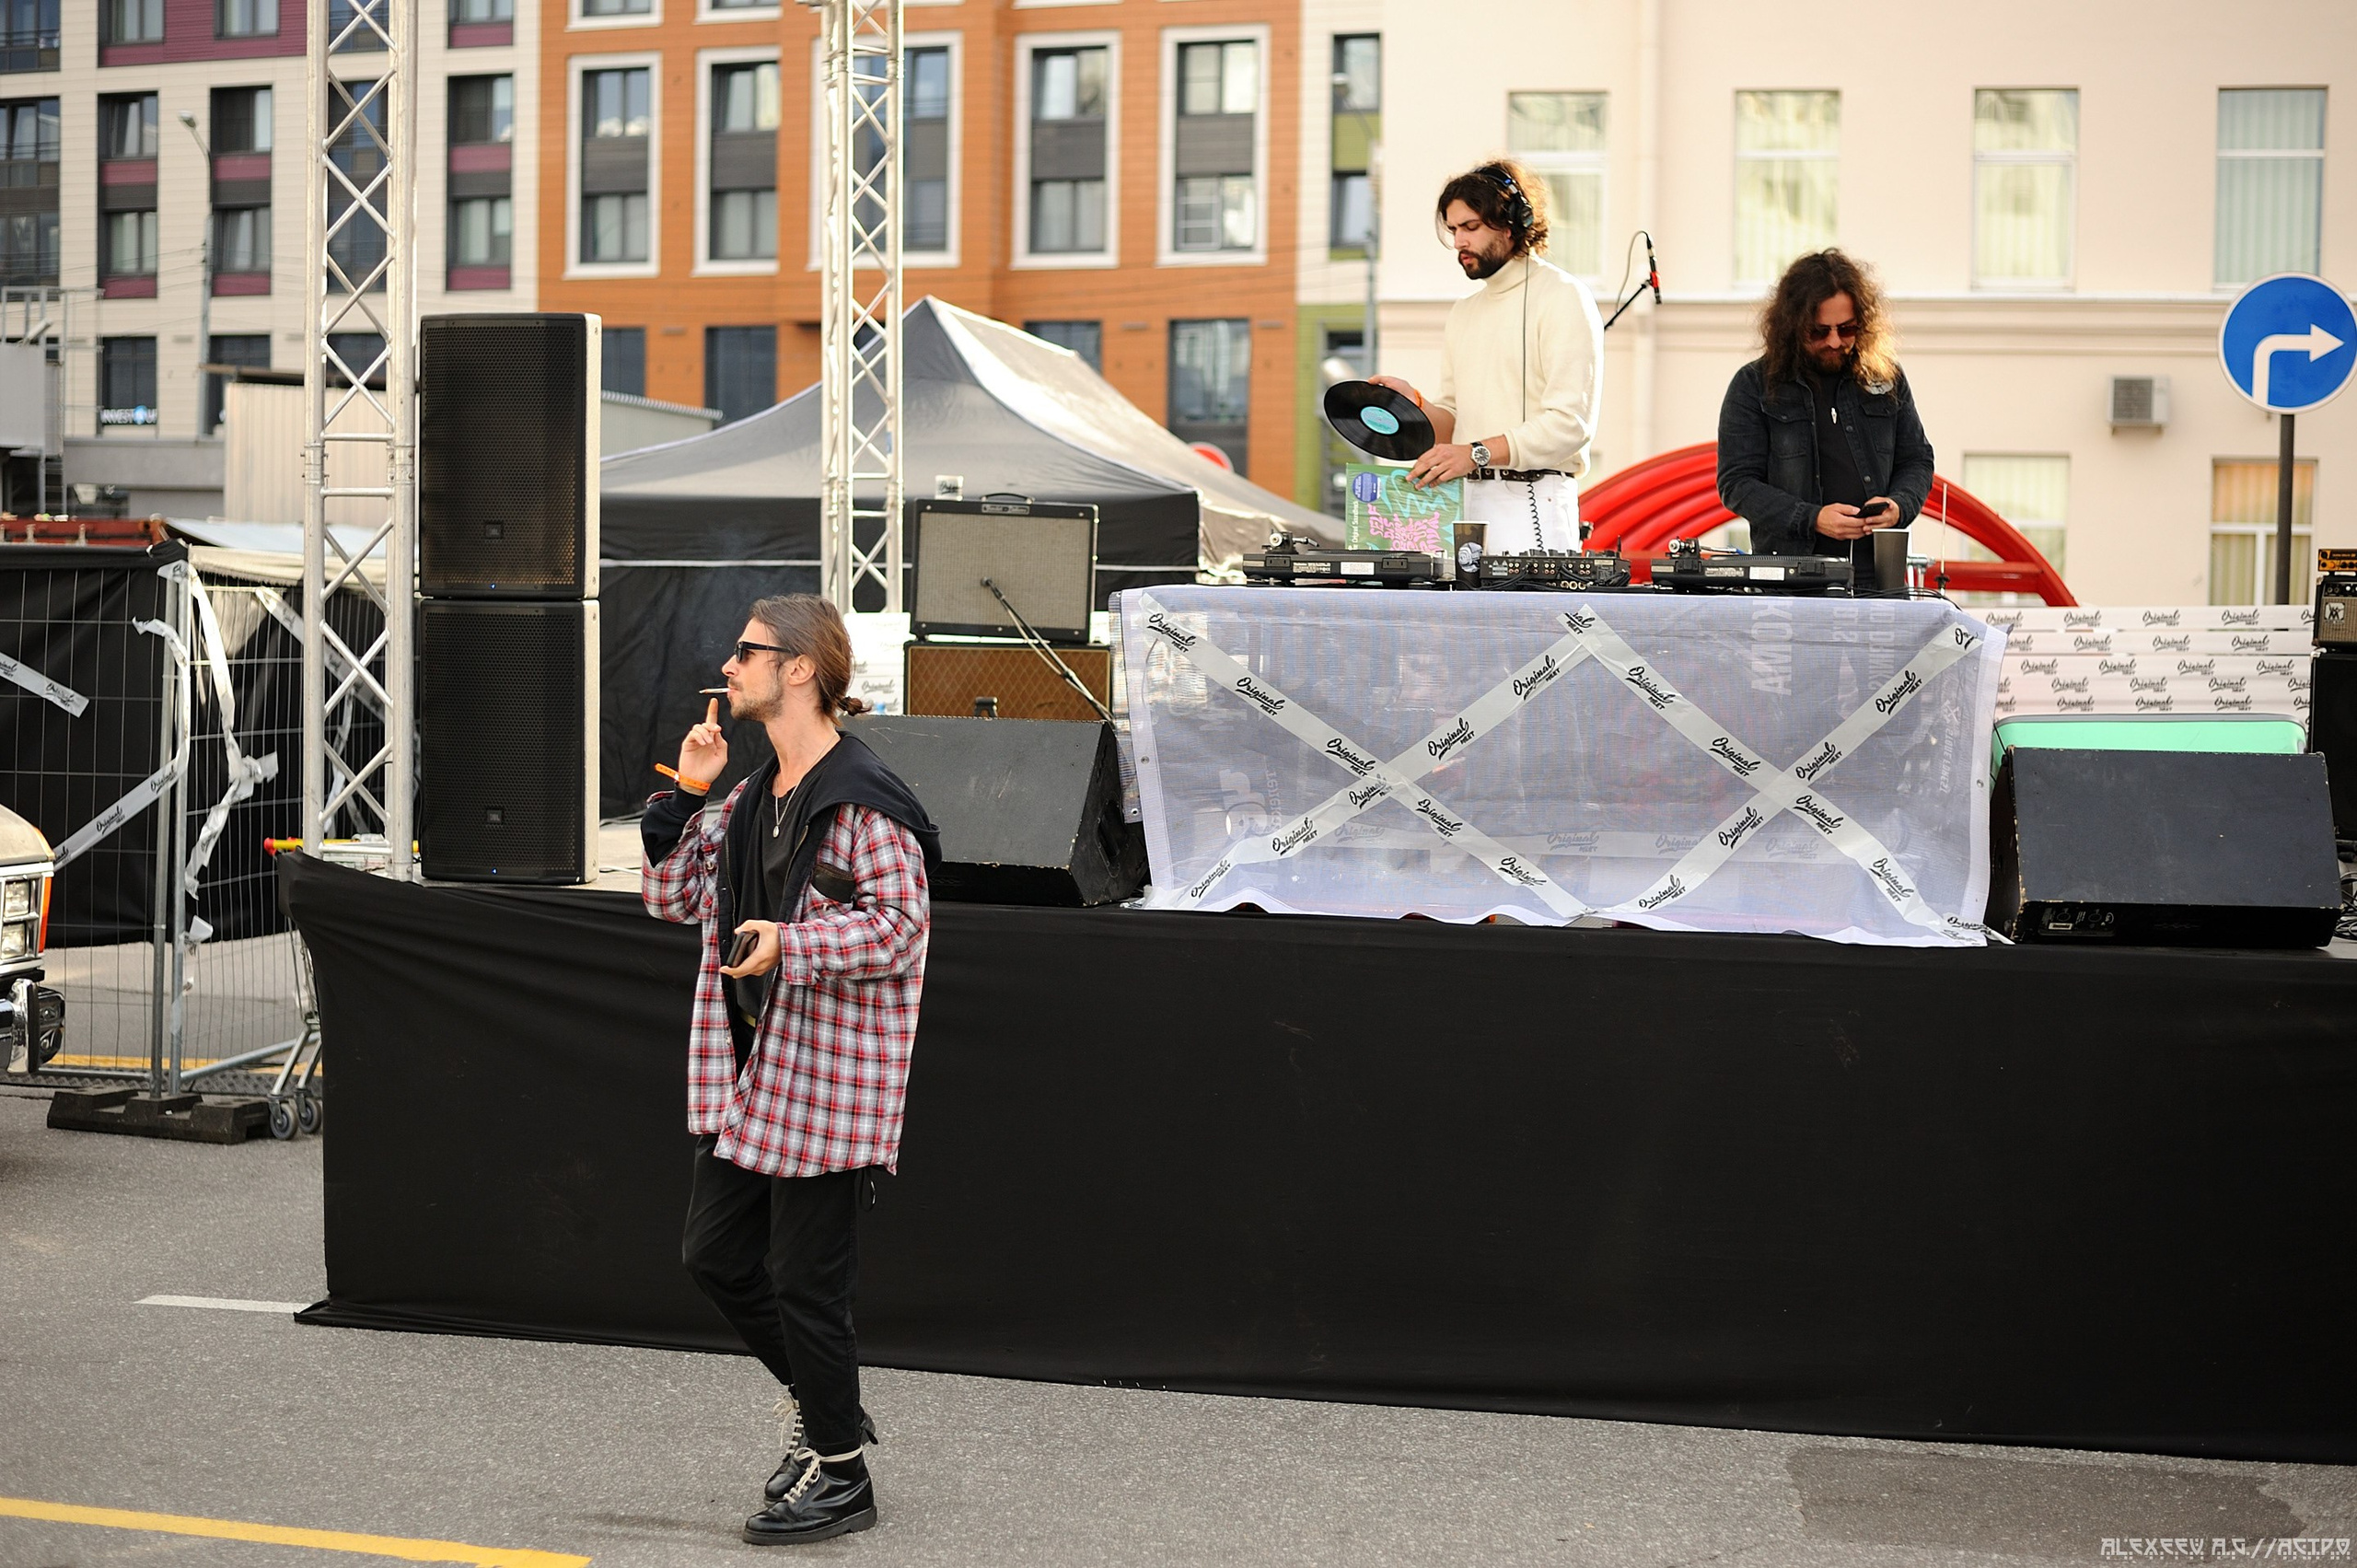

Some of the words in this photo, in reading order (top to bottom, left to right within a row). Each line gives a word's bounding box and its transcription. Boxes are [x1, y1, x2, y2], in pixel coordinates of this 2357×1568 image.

[1985, 611, 2023, 624] Original
[2063, 610, 2102, 627] Original
[2142, 610, 2180, 627] Original
[2222, 609, 2260, 626] Original
[1147, 613, 1196, 645] Original
[2073, 634, 2112, 652] Original
[2152, 634, 2190, 652] Original
[2231, 634, 2270, 652] Original
[1545, 668, 1561, 682] MEET
[2020, 658, 2058, 675] Original
[2098, 658, 2137, 675] Original
[2177, 658, 2215, 675] Original
[2256, 659, 2294, 676] Original
[1513, 655, 1556, 701] Original
[1625, 667, 1676, 703] Original
[1908, 678, 1922, 694] MEET
[2051, 677, 2089, 692] Original
[2130, 677, 2167, 692] Original
[2209, 677, 2247, 692] Original
[1235, 678, 1285, 710] Original
[1875, 669, 1916, 714] Original
[1260, 704, 1278, 716] MEET
[1648, 697, 1666, 710] MEET
[2057, 695, 2095, 712] Original
[2135, 695, 2173, 712] Original
[2214, 695, 2252, 711] Original
[1428, 717, 1469, 761] Original
[1460, 730, 1475, 745] MEET
[1325, 738, 1376, 771] Original
[1709, 737, 1761, 772] Original
[1795, 741, 1836, 781] Original
[1829, 751, 1843, 765] MEET
[1350, 765, 1368, 777] MEET
[1733, 765, 1750, 777] MEET
[97, 806, 123, 835] Original
[1416, 799, 1463, 831] Original
[1794, 795, 1844, 829] Original
[1718, 807, 1758, 850] Original
[1750, 816, 1764, 830] MEET
[1816, 821, 1833, 835] MEET
[1271, 817, 1313, 856] Original
[1191, 860, 1227, 899] Original
[1868, 857, 1914, 898] Original
[1639, 874, 1680, 909] Original
